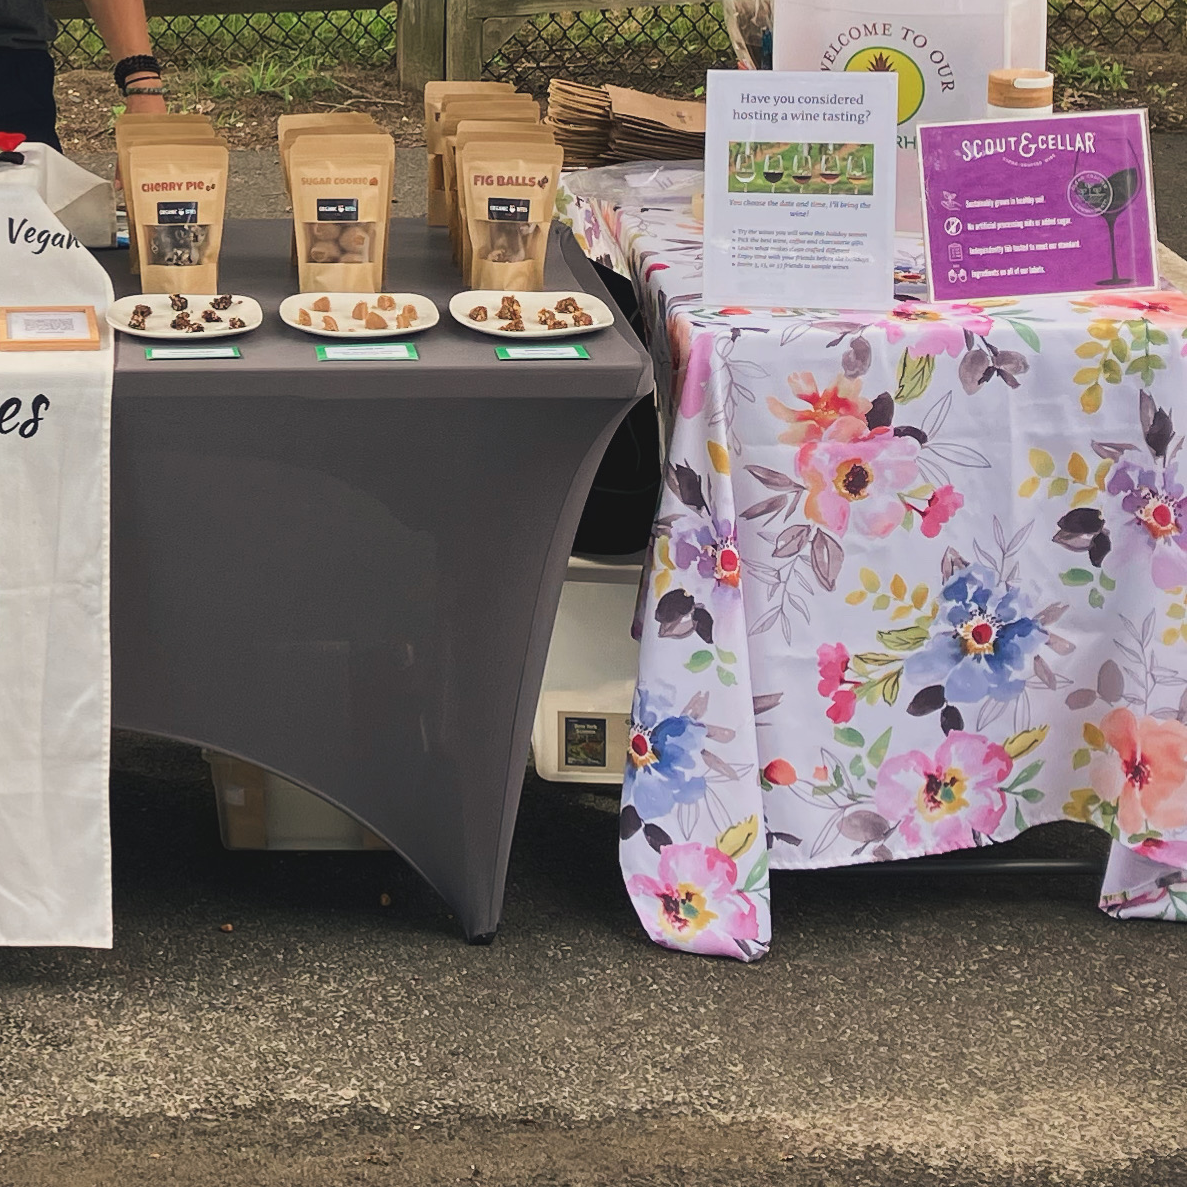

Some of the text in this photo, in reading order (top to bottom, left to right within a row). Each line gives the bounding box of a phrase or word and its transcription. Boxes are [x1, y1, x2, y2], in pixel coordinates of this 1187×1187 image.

[901, 26, 928, 49] TO
[929, 50, 955, 93] OUR
[740, 93, 864, 107] Have you considered
[732, 109, 872, 125] hosting a wine tasting?
[301, 177, 332, 185] SUGAR
[473, 174, 537, 187] FIG BALLS
[8, 217, 81, 255] Vegan
